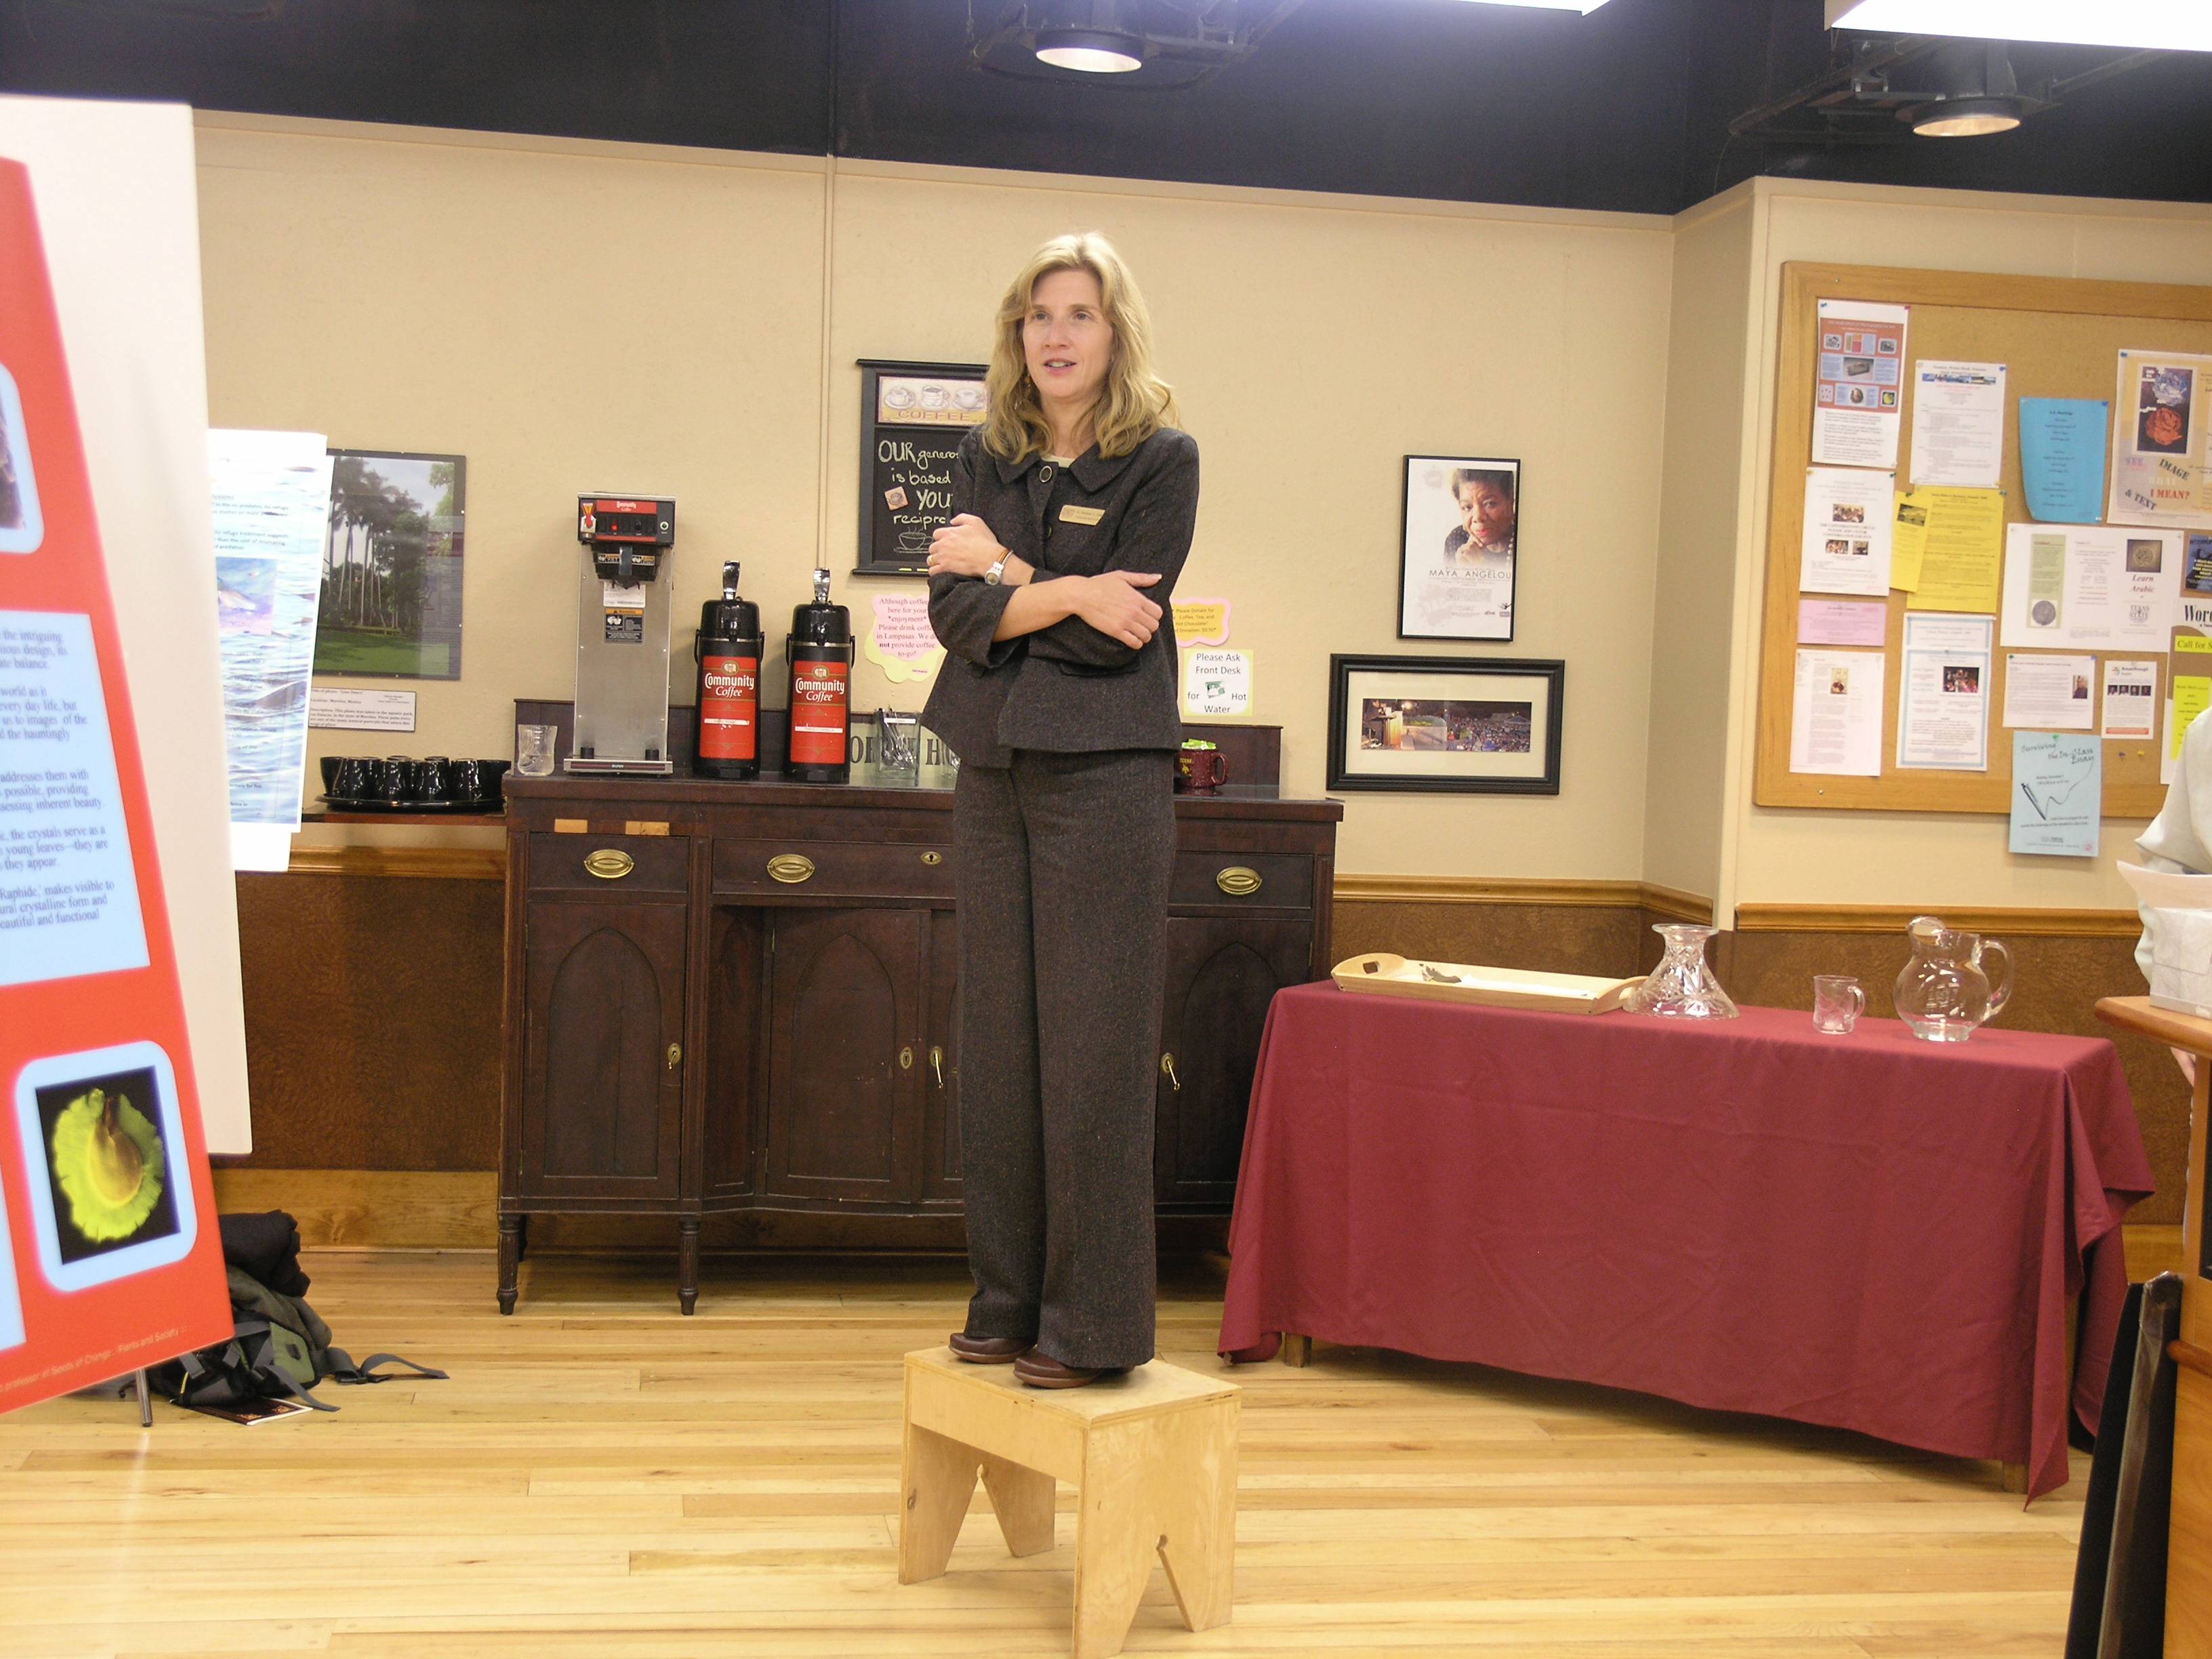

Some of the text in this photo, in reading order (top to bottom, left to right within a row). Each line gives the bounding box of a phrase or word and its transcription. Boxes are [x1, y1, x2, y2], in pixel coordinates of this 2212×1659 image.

[878, 440, 959, 470] OUR genero
[890, 467, 951, 486] is based
[2159, 459, 2190, 480] IMAGE
[2157, 489, 2190, 499] MEAN?
[2135, 493, 2156, 510] TEXT
[1465, 571, 1511, 579] ANGELOU
[2177, 640, 2192, 649] Call
[2194, 640, 2206, 649] for
[1196, 653, 1241, 661] Please Ask
[1195, 666, 1241, 674] Front Desk
[704, 672, 754, 690] Community
[795, 677, 845, 695] Community
[715, 686, 743, 699] Coffee
[806, 691, 833, 703] Coffee
[1187, 691, 1200, 699] for
[26, 701, 40, 713] day
[63, 701, 77, 711] but
[1204, 705, 1231, 713] Water
[16, 716, 25, 724] to
[27, 715, 58, 728] images
[63, 714, 73, 724] of
[74, 714, 88, 724] the
[7, 728, 22, 739] the
[24, 727, 70, 741] hauntingly
[1, 769, 89, 783] addresses them with
[47, 784, 89, 798] providing
[36, 796, 72, 810] inherent
[11, 828, 25, 841] the
[28, 825, 63, 844] crystals
[64, 826, 87, 838] serve
[89, 827, 99, 836] as
[6, 844, 34, 858] young
[96, 840, 109, 849] are
[5, 859, 24, 872] they
[44, 883, 73, 897] makes
[75, 880, 104, 893] visible
[106, 880, 115, 890] to
[20, 897, 66, 914] crystalline
[68, 896, 90, 909] form
[91, 893, 108, 906] and
[37, 913, 54, 926] and
[56, 907, 100, 924] functional
